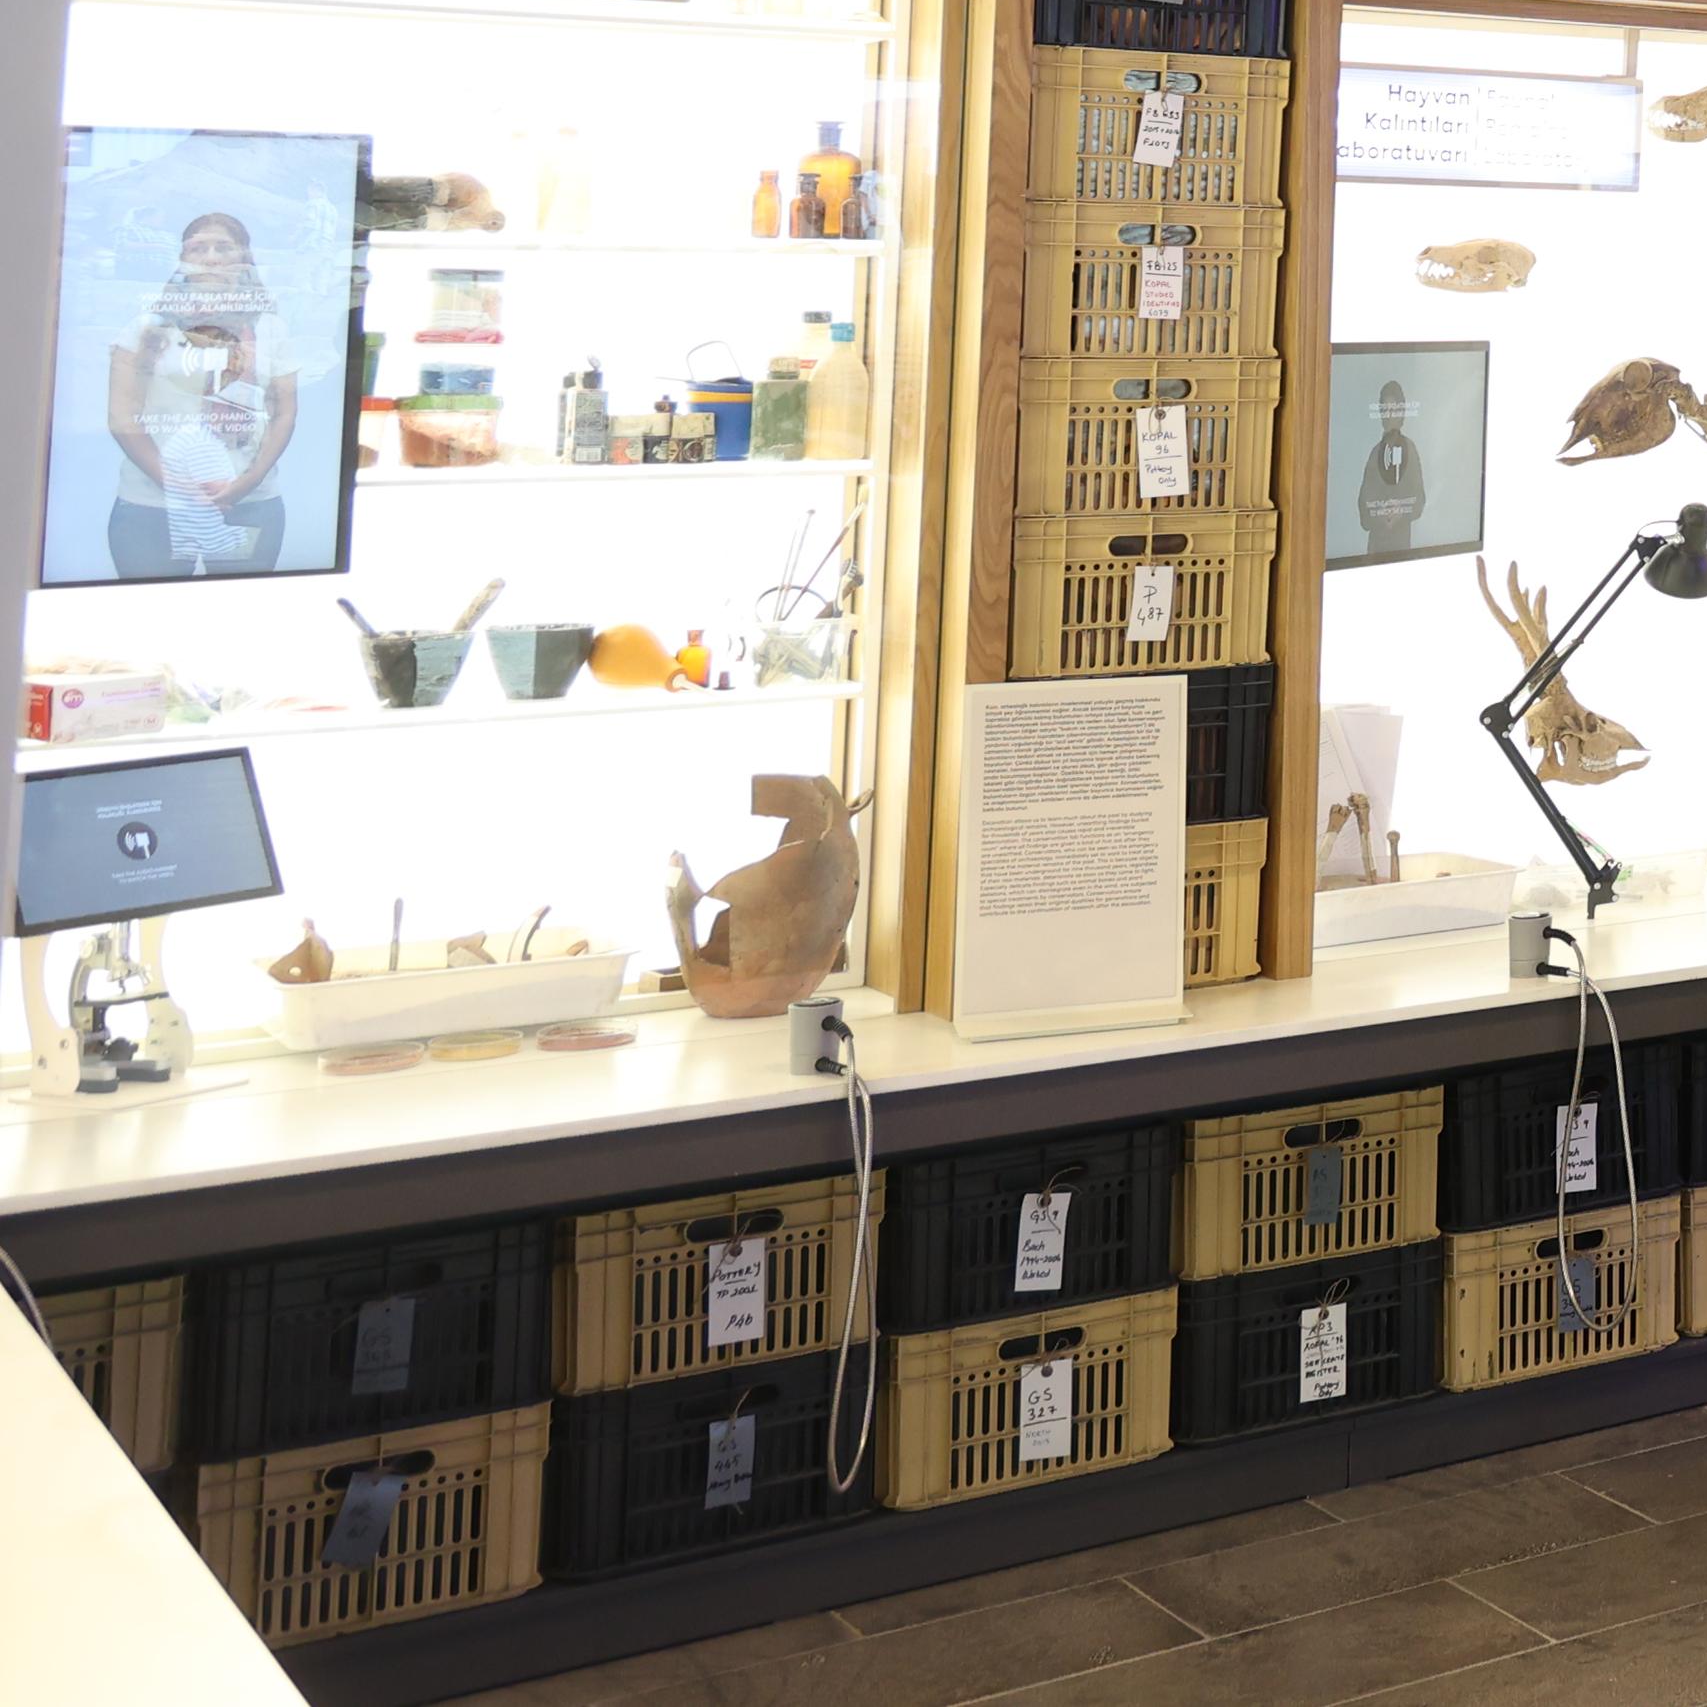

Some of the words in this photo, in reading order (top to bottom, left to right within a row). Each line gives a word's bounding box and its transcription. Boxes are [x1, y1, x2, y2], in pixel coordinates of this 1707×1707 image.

[1388, 84, 1470, 108] Hayvan
[1364, 112, 1468, 135] Kalıntıları
[1337, 142, 1468, 163] aboratuvarı
[1145, 280, 1171, 289] KOPAL
[1142, 431, 1178, 442] KOPAL
[711, 1261, 761, 1283] POTTERY
[1028, 1388, 1053, 1403] GS
[1027, 1406, 1057, 1420] 327
